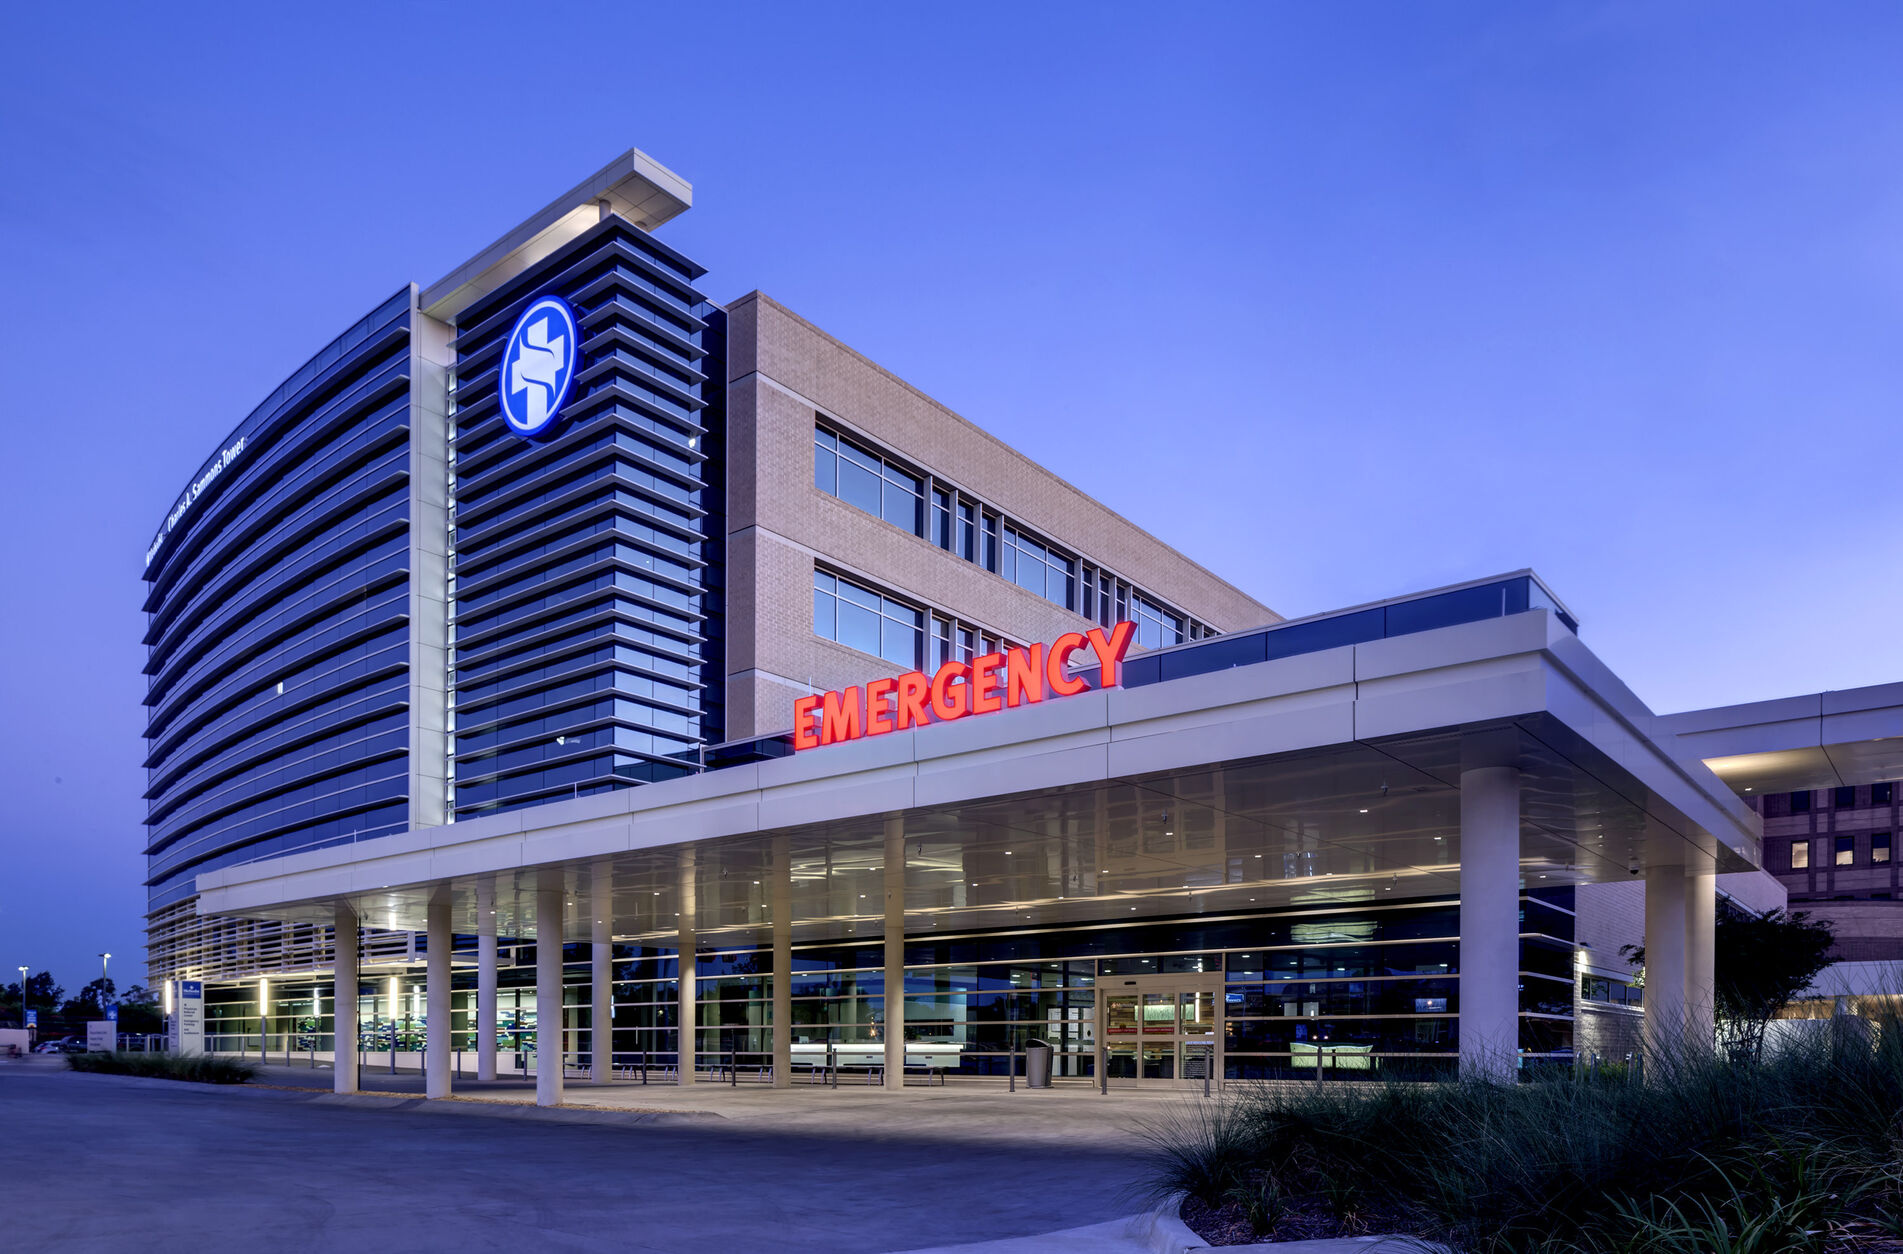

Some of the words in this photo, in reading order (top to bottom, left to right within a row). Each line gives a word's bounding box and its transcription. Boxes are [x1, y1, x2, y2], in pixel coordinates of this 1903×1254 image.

[192, 459, 222, 501] Sammons
[222, 437, 244, 468] Tower
[794, 620, 1138, 751] EMERGENCY
